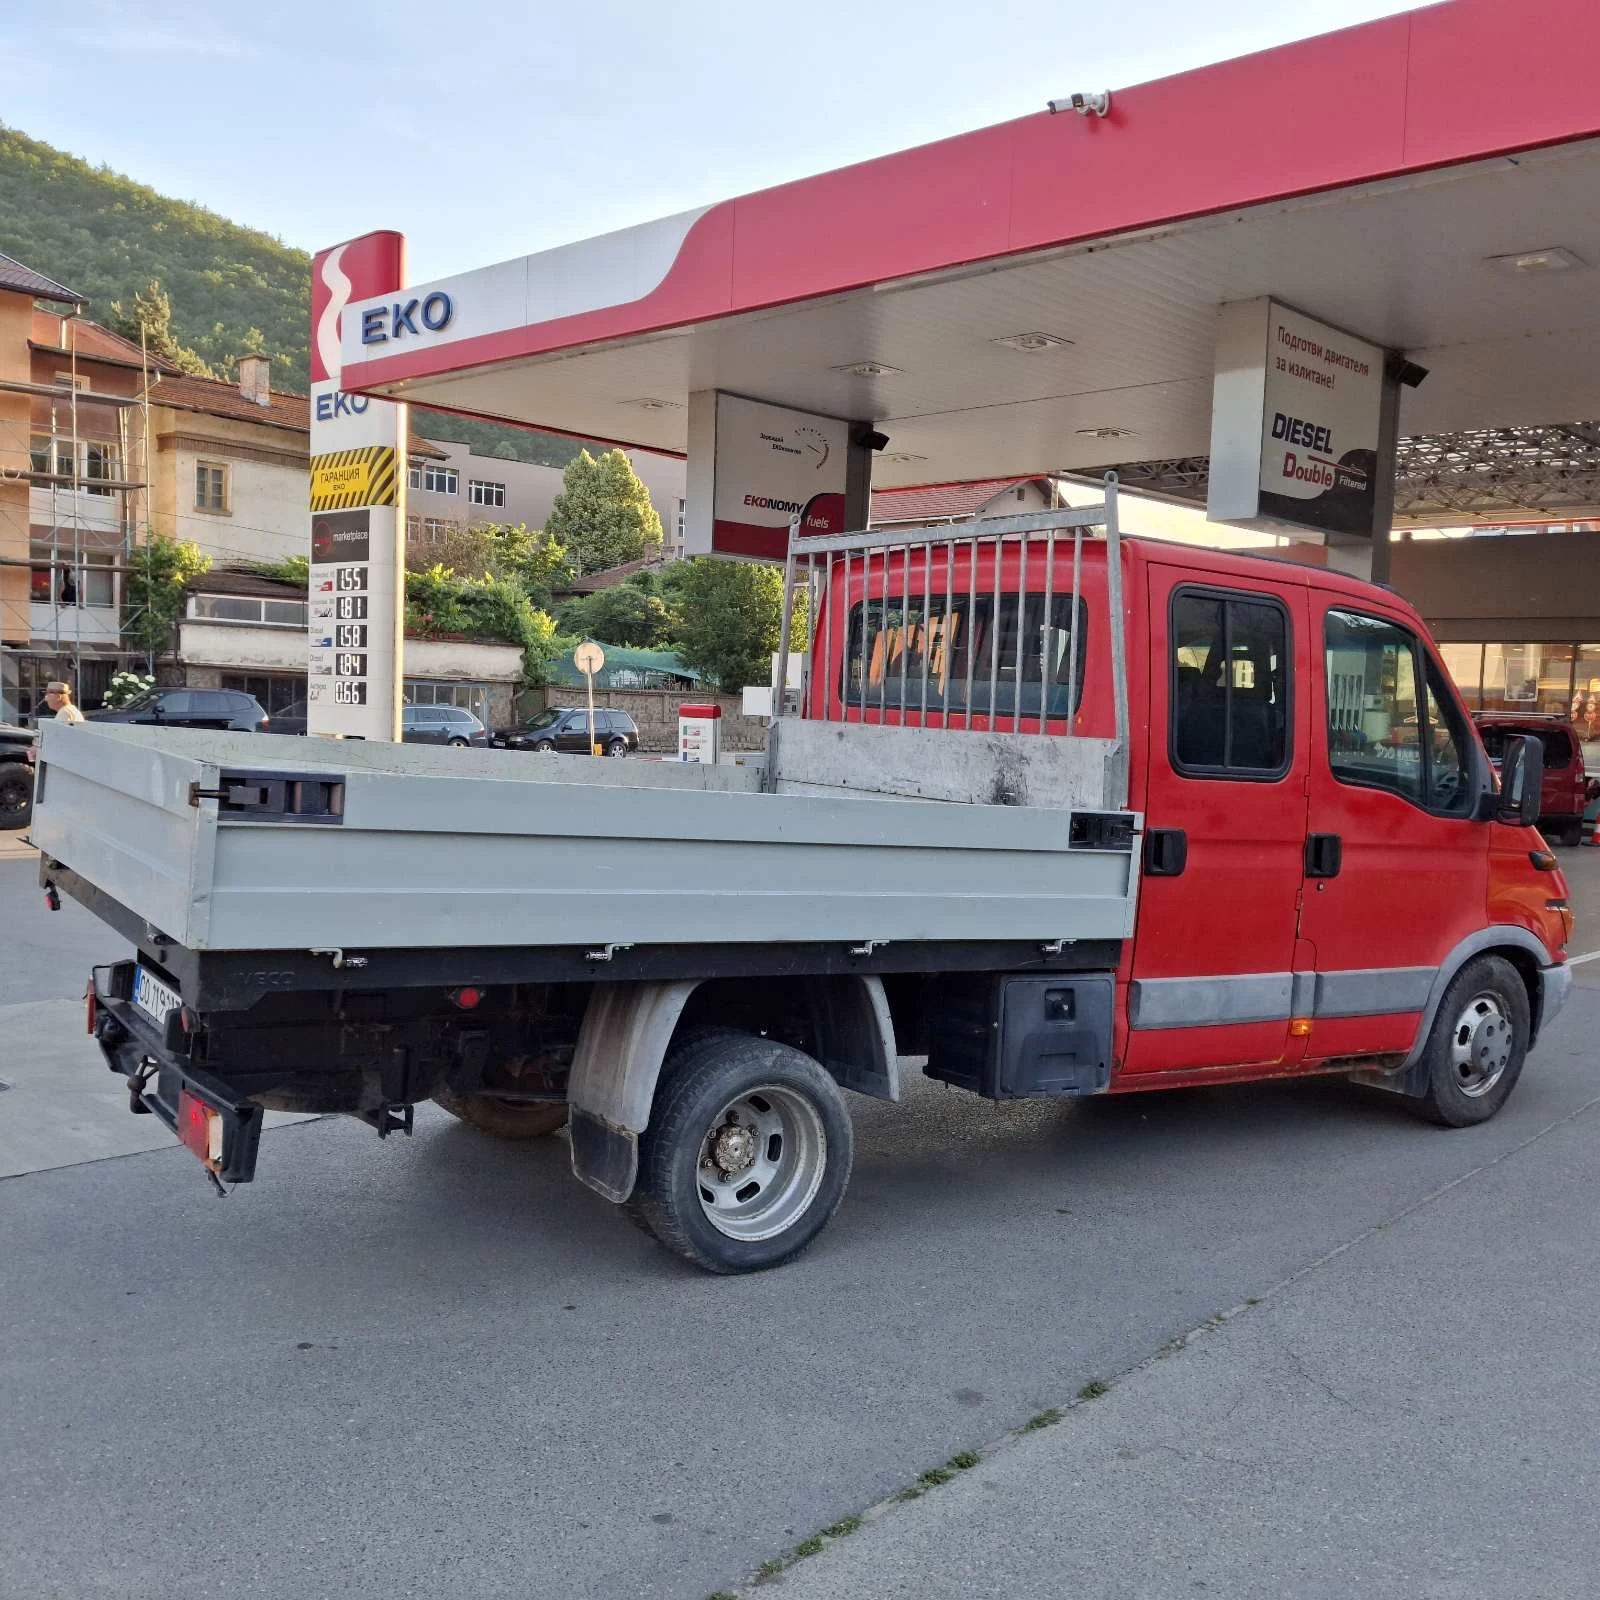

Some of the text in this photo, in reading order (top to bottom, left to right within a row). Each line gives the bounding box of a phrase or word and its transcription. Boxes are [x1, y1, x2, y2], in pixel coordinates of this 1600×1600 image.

[362, 291, 453, 344] EKO
[1278, 326, 1369, 376] Подготви двигателя
[1276, 357, 1336, 389] за излитане!
[316, 392, 369, 421] EKO
[1271, 412, 1333, 454] DIESEL
[320, 467, 360, 483] ГАРАНЦИЯ
[1282, 451, 1333, 487] Double
[1339, 475, 1367, 490] Filtered
[743, 494, 804, 513] EKONOMY
[806, 515, 829, 529] fuels
[332, 529, 368, 542] marketplace
[233, 971, 297, 985] VECO
